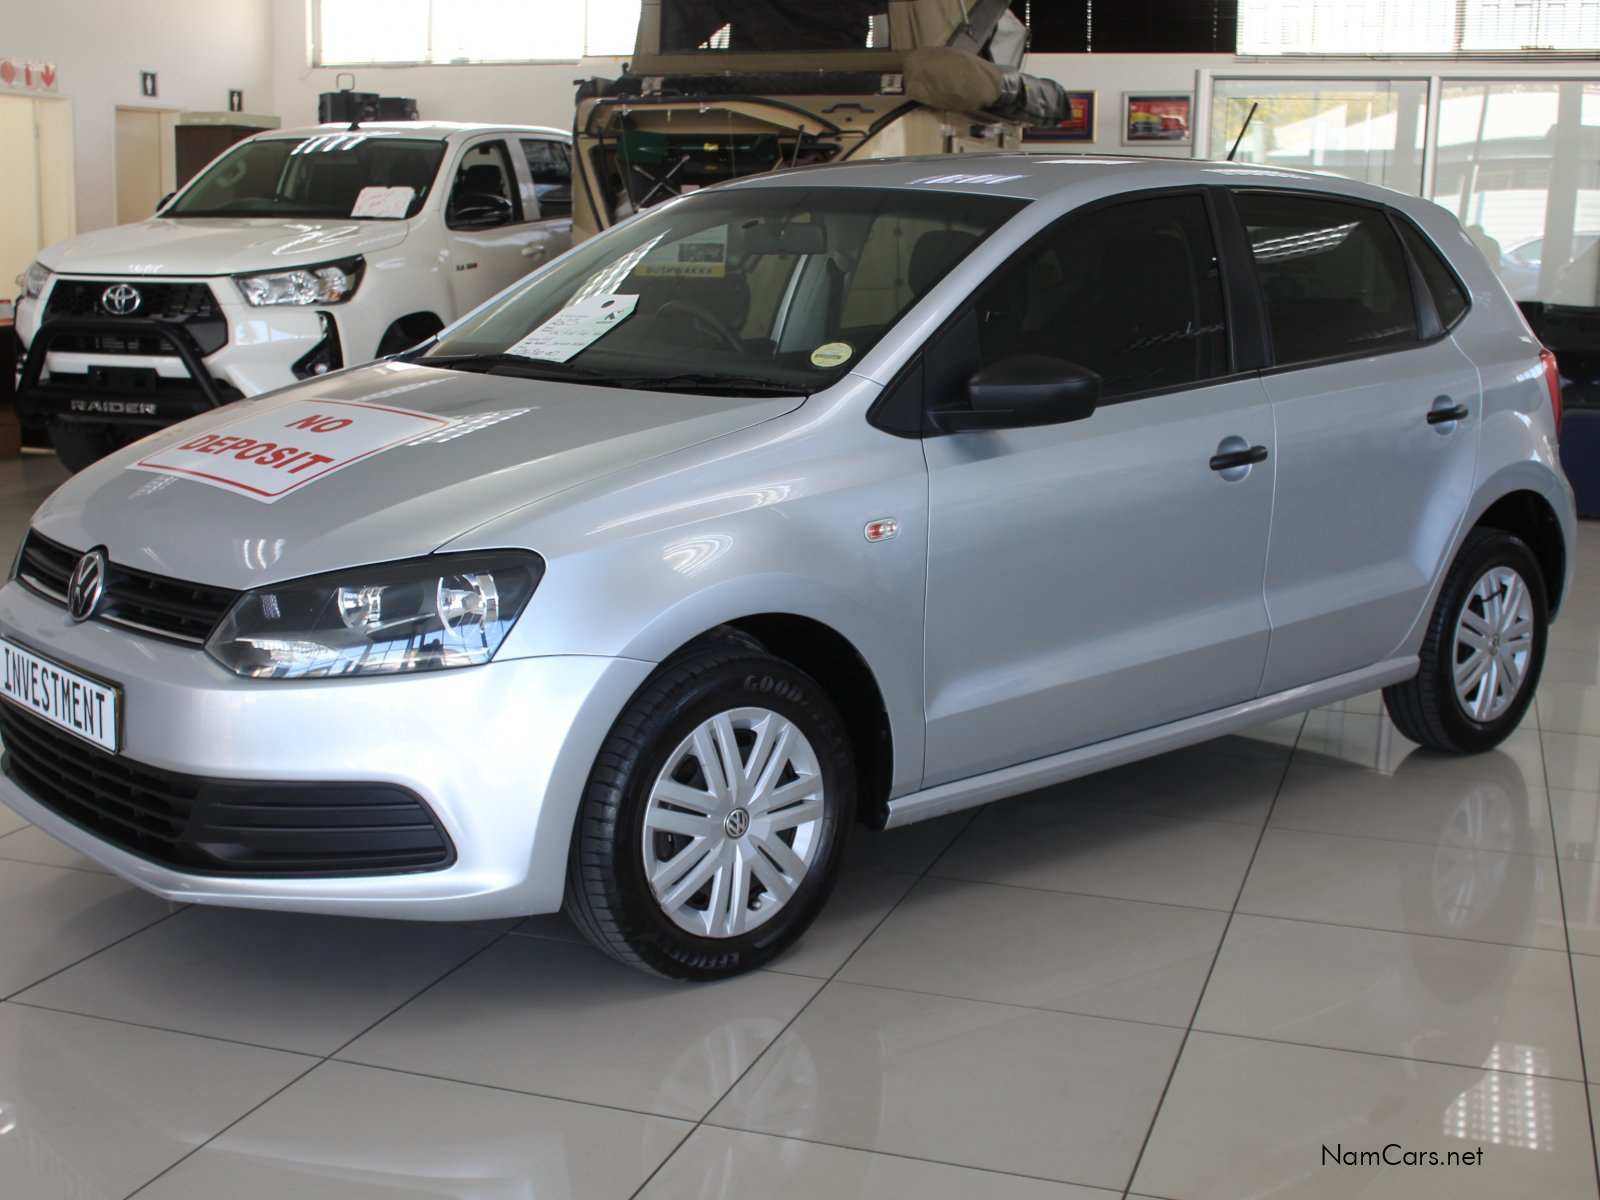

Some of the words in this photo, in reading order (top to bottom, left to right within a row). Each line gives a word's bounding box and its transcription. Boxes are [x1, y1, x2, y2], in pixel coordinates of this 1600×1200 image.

[71, 400, 156, 415] RAIDER
[284, 414, 353, 433] NO
[178, 434, 335, 474] DEPOSIT
[4, 648, 105, 739] INVESTMENT
